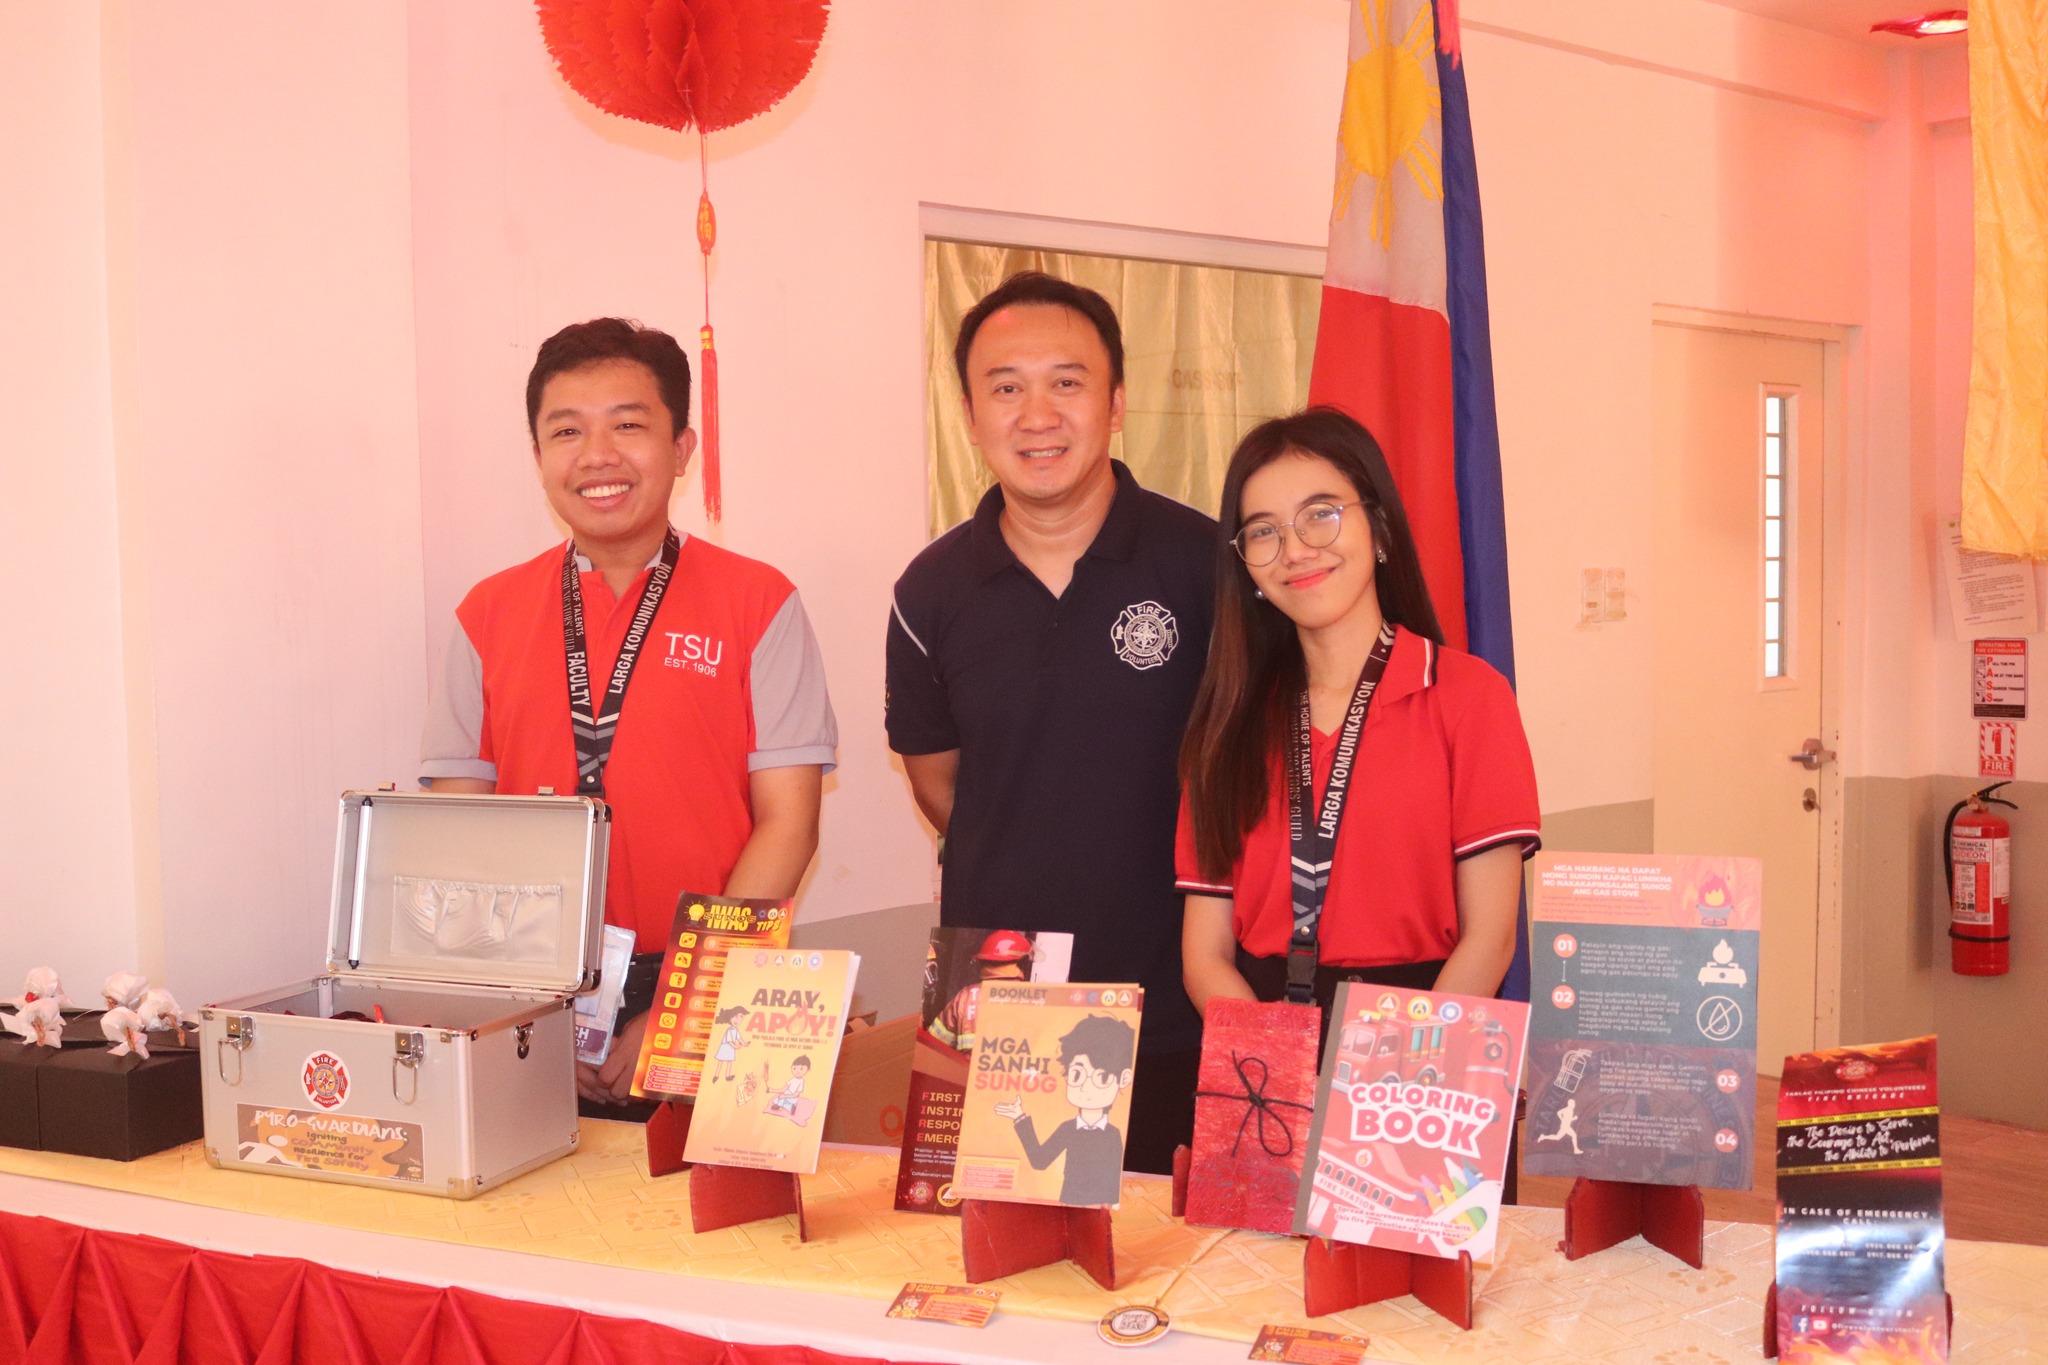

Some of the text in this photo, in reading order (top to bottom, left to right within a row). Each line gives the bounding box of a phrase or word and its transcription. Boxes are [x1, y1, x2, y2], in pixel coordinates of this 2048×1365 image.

[571, 568, 579, 590] HOME
[573, 592, 581, 601] OF
[1137, 605, 1161, 616] FIRE
[573, 602, 584, 637] TALENTS
[608, 562, 672, 695] LARGA KOMUNIKASYON
[664, 632, 723, 666] TSU
[1126, 652, 1161, 665] VOLUNTEER
[664, 657, 717, 678] EST. 1906
[567, 651, 592, 707] FACULTY
[1300, 707, 1309, 731] HOME
[1301, 733, 1310, 744] OF
[1302, 746, 1312, 787] TALENTS
[1318, 681, 1376, 839] LARGA KOMUNIKASYON
[1985, 761, 2009, 770] FIRE
[1603, 874, 1632, 882] KAPAG
[1634, 875, 1672, 883] LUMIKHA
[1632, 867, 1662, 875] DAPAT
[1557, 880, 1639, 889] NAKAKAPINSALANG
[1641, 883, 1671, 891] SUNOG
[703, 912, 757, 923] SUNOG
[707, 905, 751, 931] IWAS
[757, 920, 781, 932] TIPS
[1557, 940, 1573, 951] 01
[751, 988, 825, 1013] ARAY,
[989, 988, 1048, 999] BOOKLET
[1554, 992, 1572, 1003] 02
[981, 1037, 1031, 1055] MGA
[977, 1054, 1051, 1074] SANHI
[974, 1072, 1057, 1093] SUNOG
[1718, 1075, 1737, 1087] 03
[922, 1091, 961, 1102] FIRST
[1350, 1084, 1495, 1121] COLORING
[919, 1119, 960, 1130] RESPO
[1354, 1108, 1481, 1152] BOOK
[1804, 1125, 1825, 1138] The
[1828, 1124, 1863, 1137] Desire
[1865, 1121, 1875, 1134] to
[1715, 1133, 1737, 1146] 04
[1787, 1135, 1804, 1148] the
[1807, 1136, 1853, 1149] Courage
[1856, 1134, 1867, 1147] to
[1825, 1150, 1839, 1162] the
[1843, 1148, 1877, 1162] Ability
[1879, 1145, 1888, 1157] to
[1319, 1178, 1376, 1211] FIRE STATION
[1783, 1207, 1795, 1215] IN
[1801, 1208, 1830, 1216] CASE
